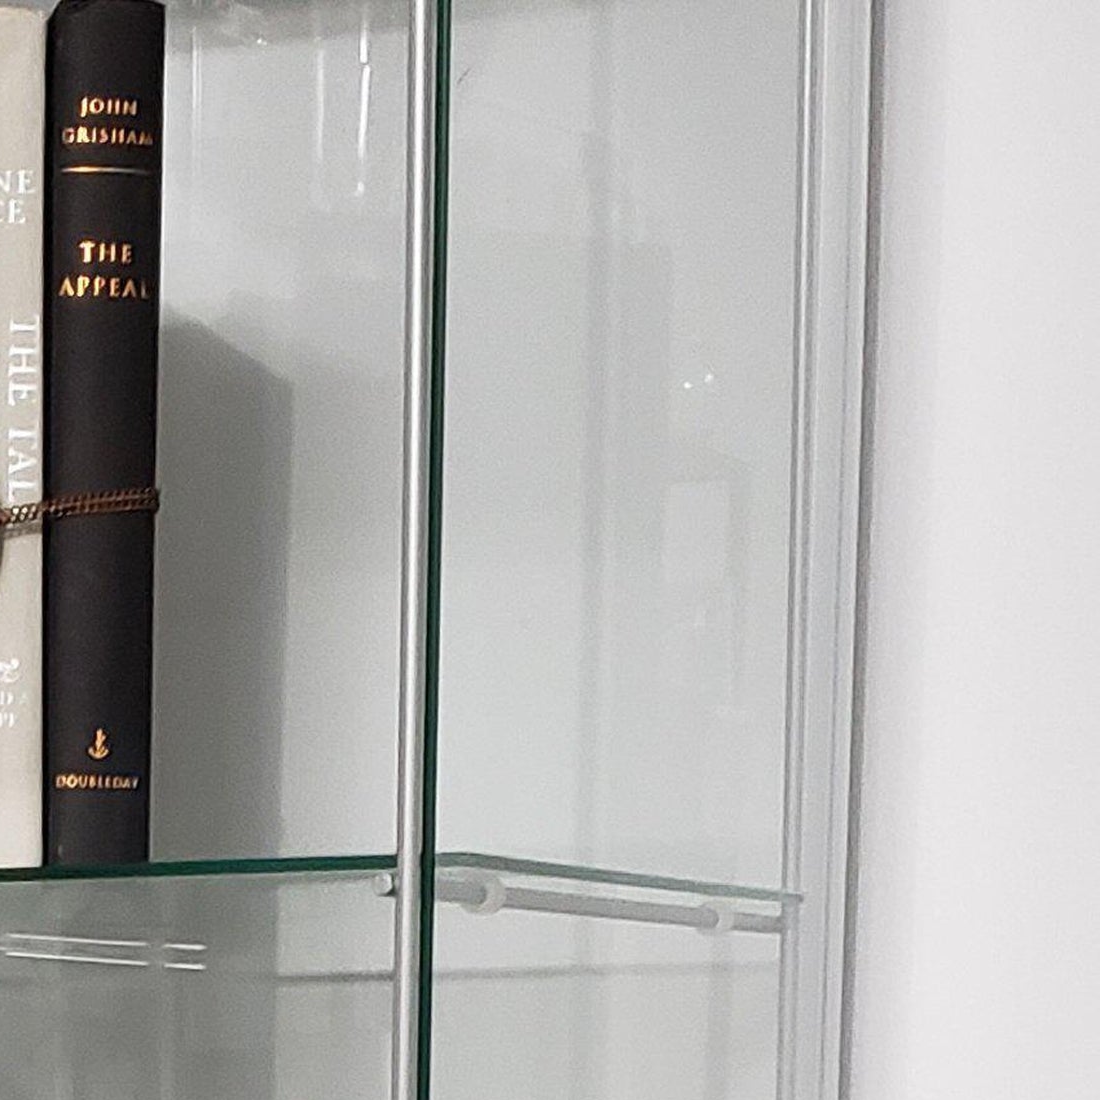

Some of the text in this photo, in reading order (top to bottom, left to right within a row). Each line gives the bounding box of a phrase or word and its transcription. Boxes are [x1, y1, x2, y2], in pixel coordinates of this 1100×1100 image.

[80, 96, 138, 118] JOHN
[61, 126, 154, 145] GRISHAM
[78, 240, 133, 264] THE
[58, 274, 150, 300] APPEAL
[8, 313, 41, 504] THE TAL
[54, 773, 140, 790] DOUBLEDAY
